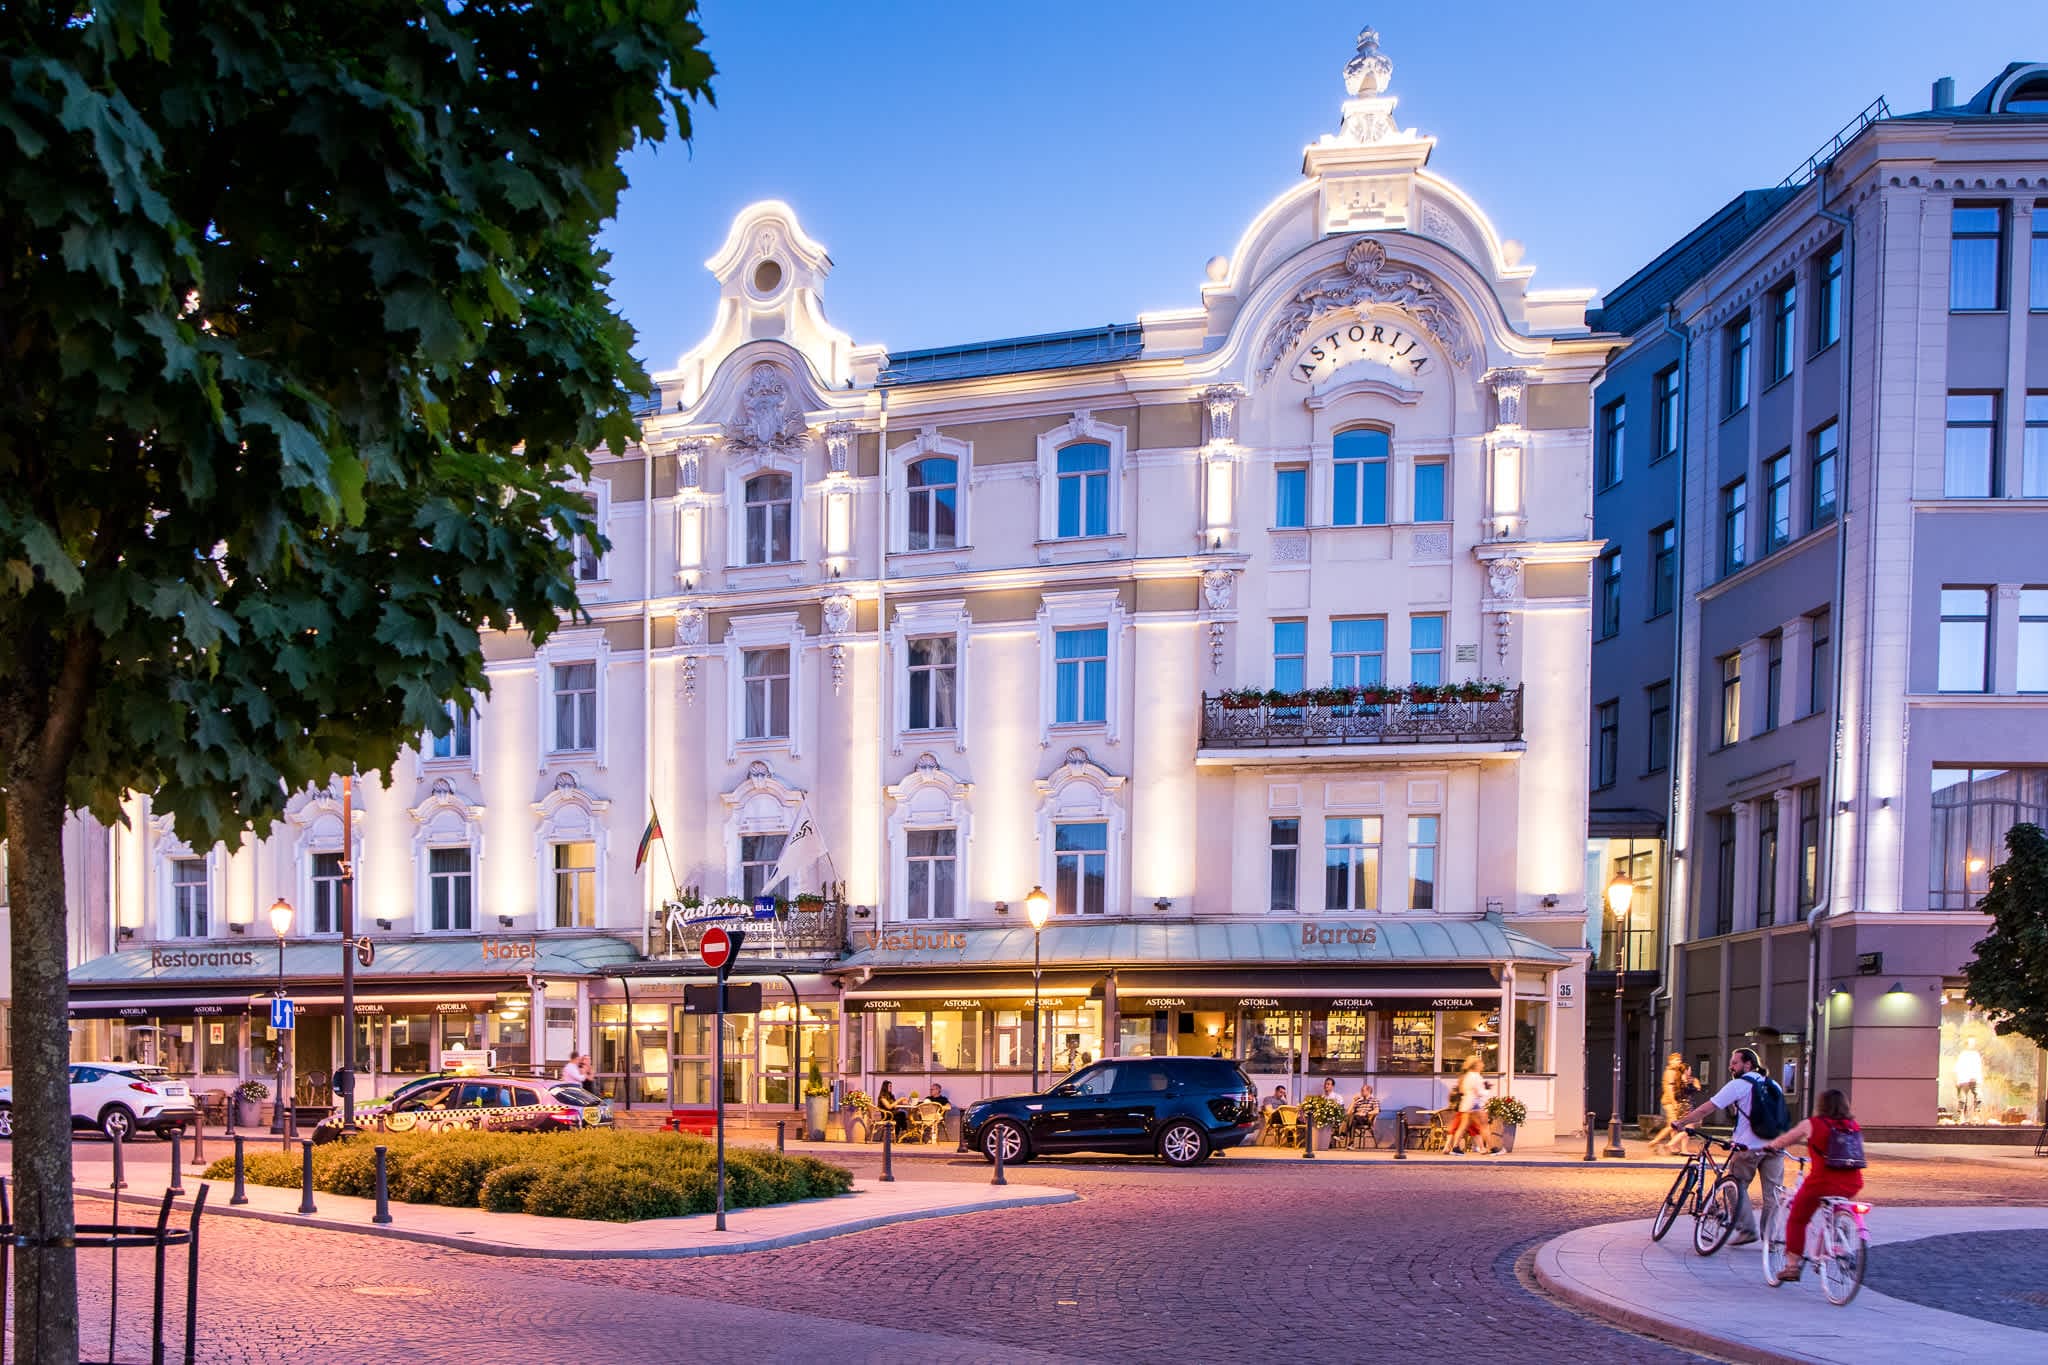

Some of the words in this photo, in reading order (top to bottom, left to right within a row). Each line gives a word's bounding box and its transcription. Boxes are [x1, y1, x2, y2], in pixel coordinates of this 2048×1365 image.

[1299, 325, 1428, 379] ASTORIJA
[666, 895, 753, 932] Radisson
[755, 904, 774, 912] BLU
[741, 922, 776, 932] HOTEL
[1302, 922, 1376, 945] Baras
[482, 938, 536, 960] Hotel
[152, 950, 253, 968] Restoranas
[1560, 984, 1571, 996] 35
[943, 999, 980, 1007] ASTORIJA
[1024, 998, 1063, 1006] ASORIJA
[1145, 998, 1185, 1006] ASTORIJA
[1238, 998, 1279, 1006] ASTORIJA
[119, 1007, 147, 1015] ASTORIJA
[353, 1004, 384, 1012] ASTORIJA
